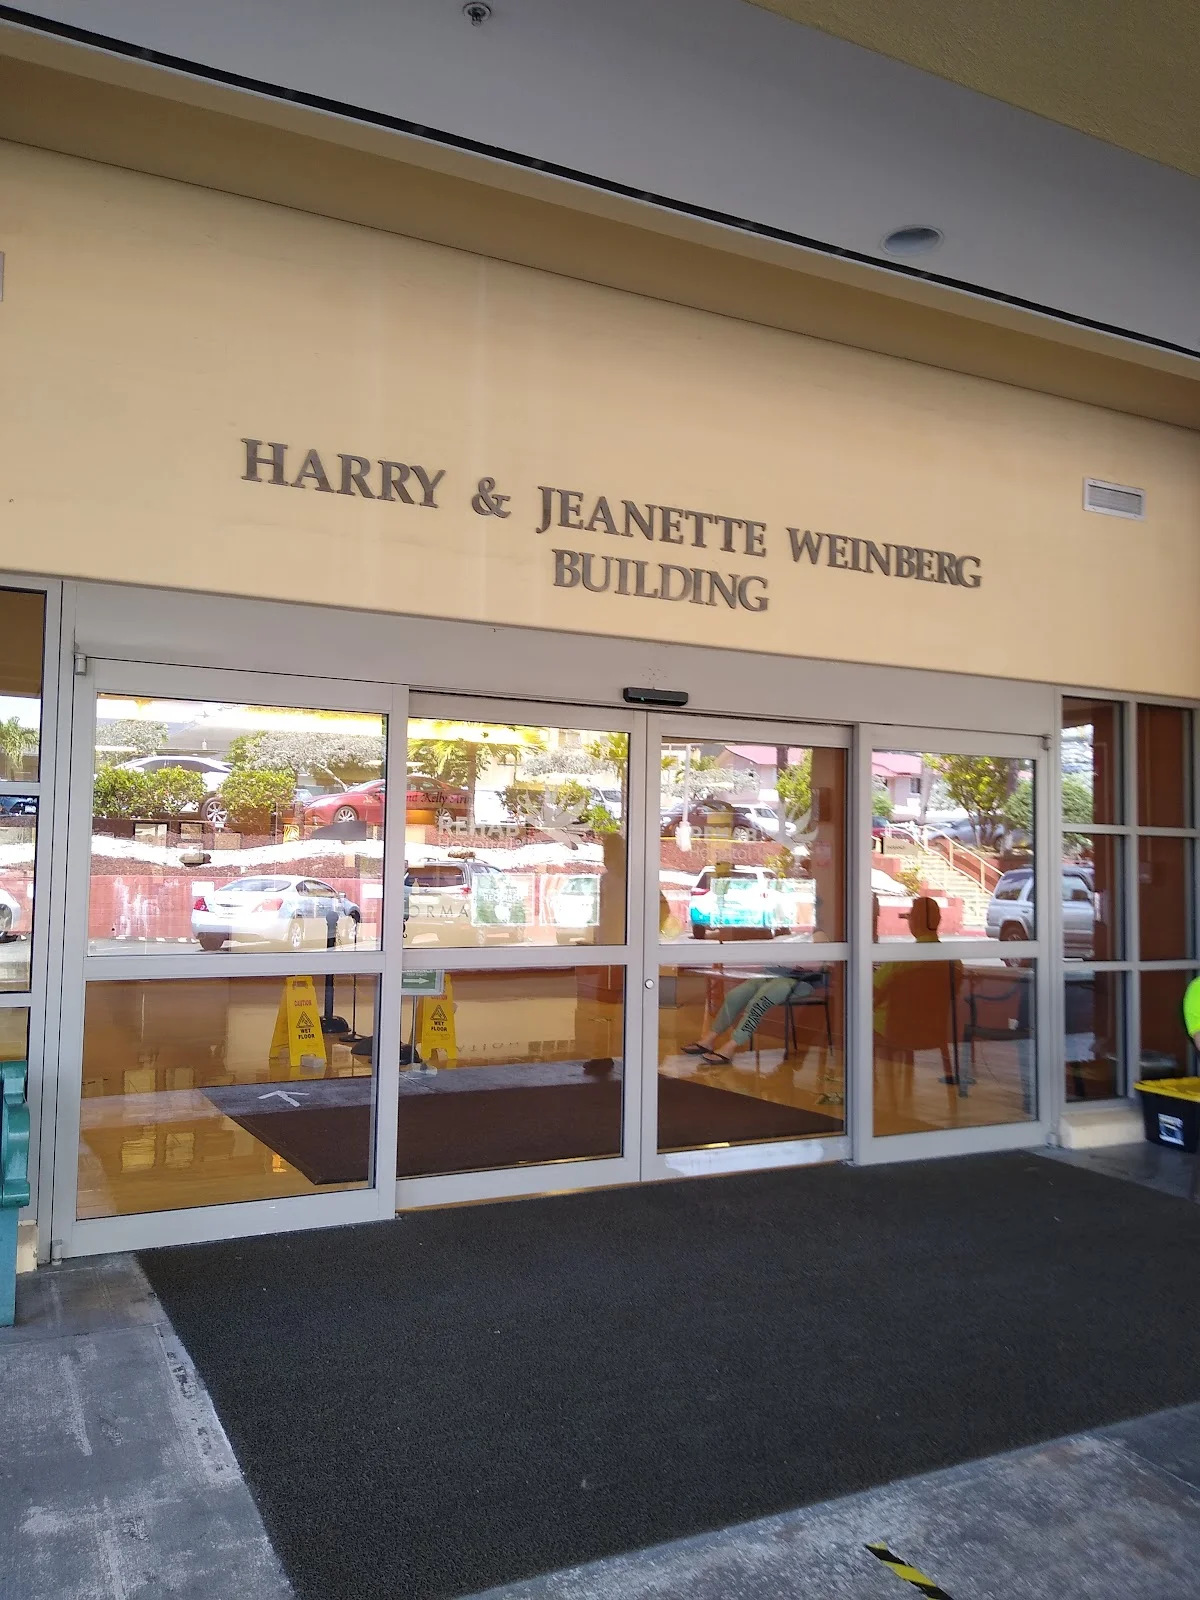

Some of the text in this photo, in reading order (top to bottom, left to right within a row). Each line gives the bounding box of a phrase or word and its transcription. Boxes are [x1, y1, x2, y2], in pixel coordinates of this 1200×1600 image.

[240, 438, 983, 590] HARRY & JEANETTE WEINBERG
[551, 548, 769, 613] BUILDING
[420, 791, 448, 808] Kelly
[294, 999, 313, 1007] CAUTION
